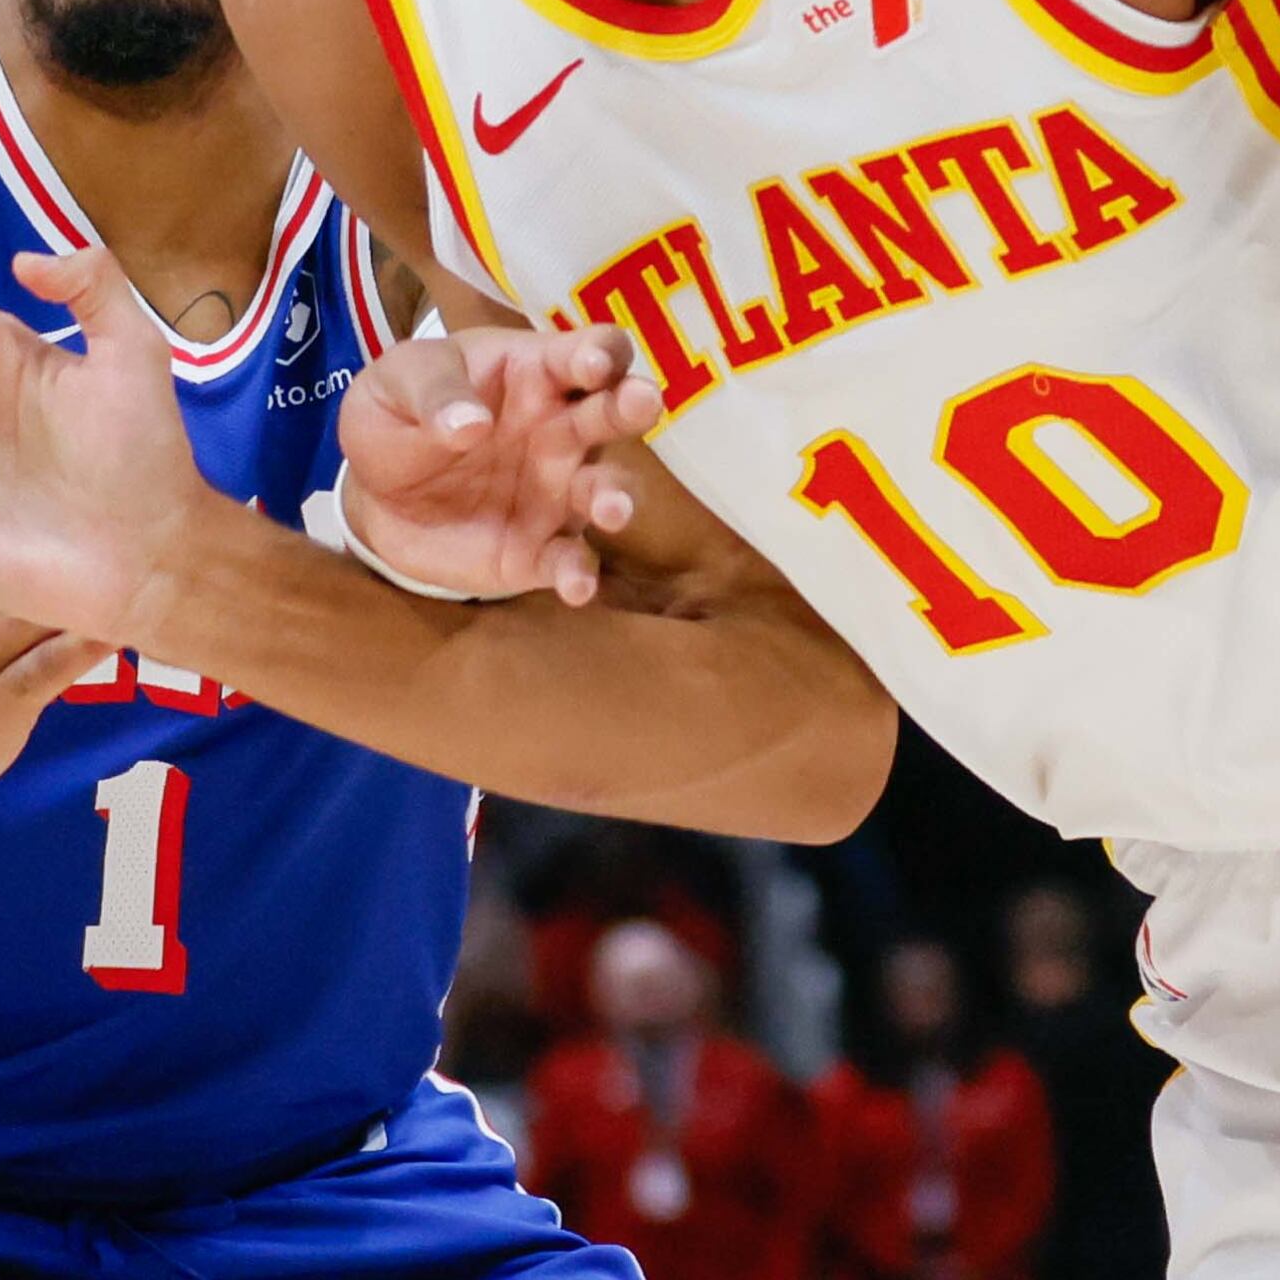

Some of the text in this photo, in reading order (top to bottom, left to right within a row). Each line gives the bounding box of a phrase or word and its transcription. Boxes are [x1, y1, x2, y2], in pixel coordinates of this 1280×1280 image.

[549, 100, 1184, 440] TLANTA
[789, 361, 1251, 657] 10
[82, 760, 190, 995] 1
